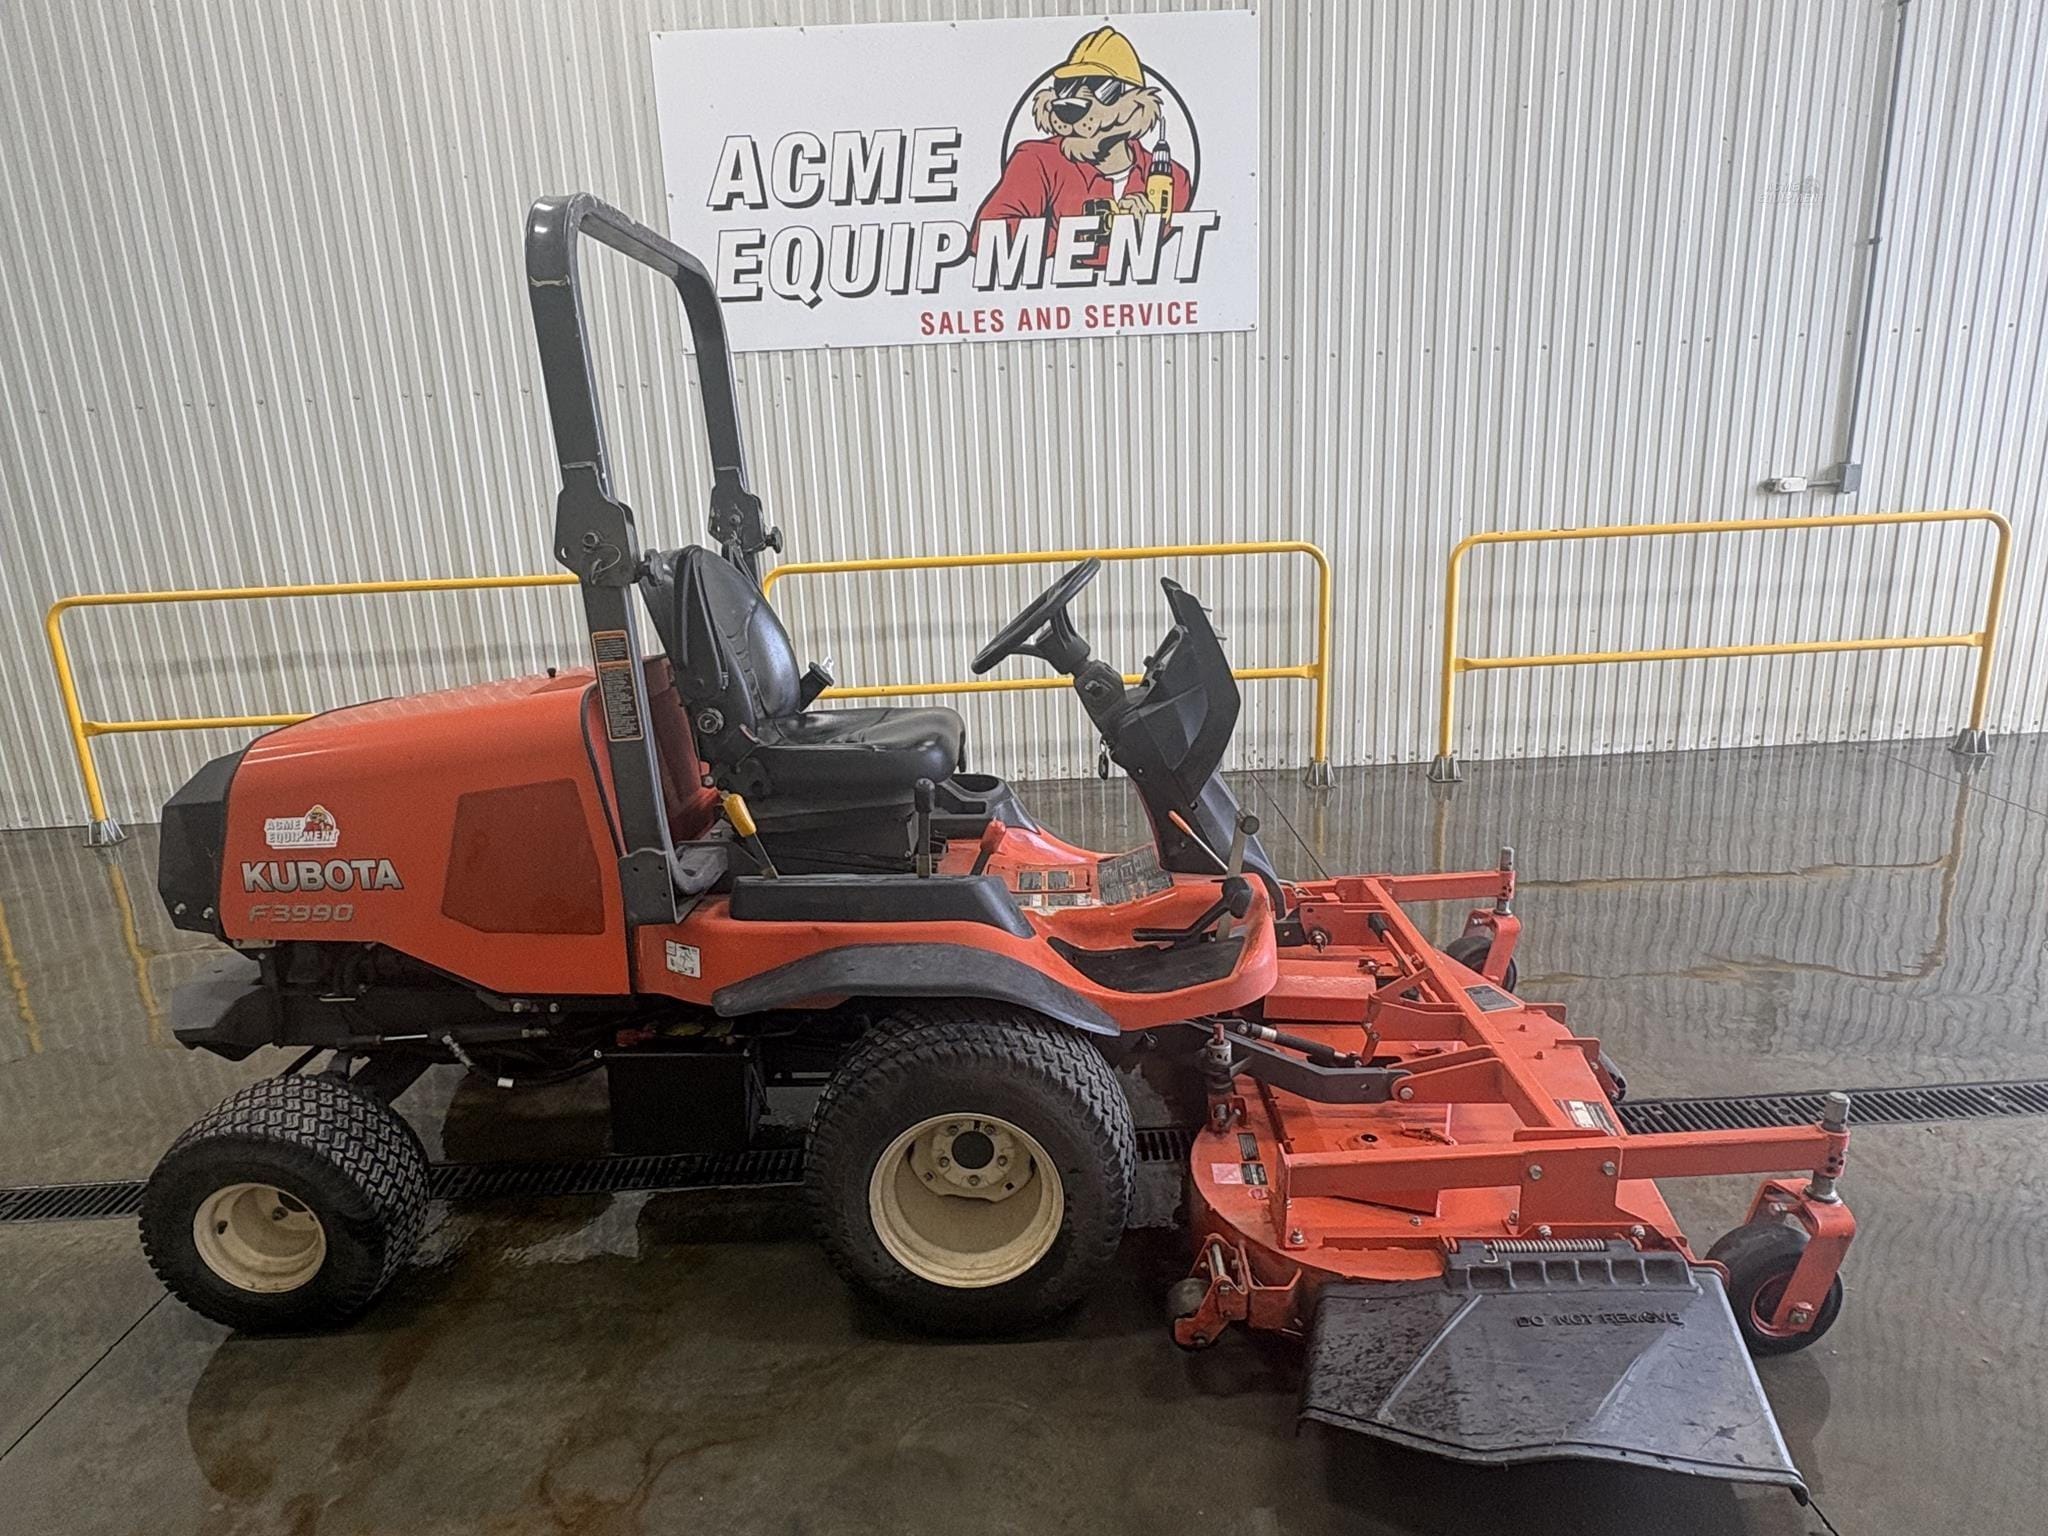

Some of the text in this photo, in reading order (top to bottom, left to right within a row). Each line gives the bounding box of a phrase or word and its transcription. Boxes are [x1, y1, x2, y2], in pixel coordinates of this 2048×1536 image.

[706, 126, 962, 211] ACME
[715, 210, 1221, 308] EQUIPMENT
[919, 301, 1199, 337] SALES AND SERVICE
[266, 819, 302, 831] ACME
[268, 830, 339, 844] EQUIPMENT
[240, 858, 405, 893] KUBOTA
[249, 903, 355, 923] F3990
[1515, 1311, 1684, 1328] DO NOT REMOVE
